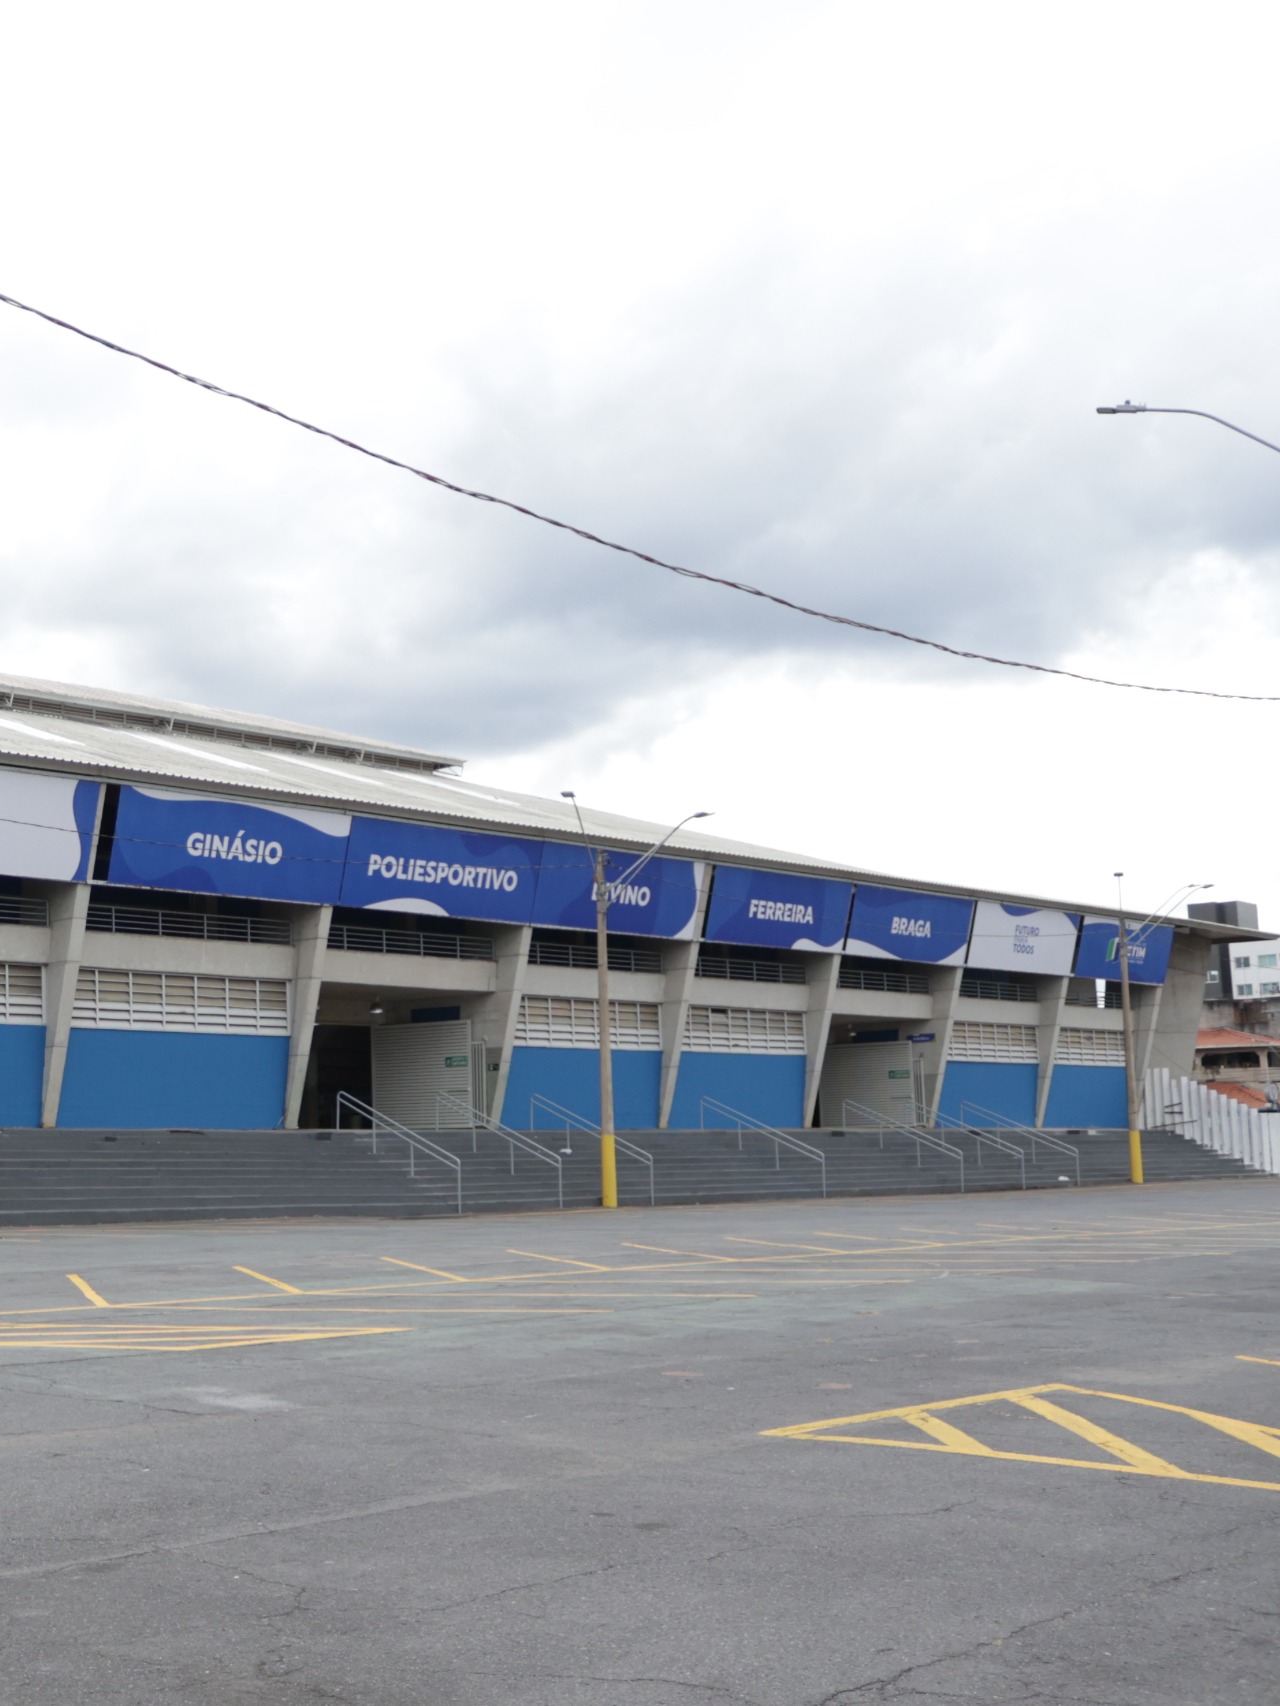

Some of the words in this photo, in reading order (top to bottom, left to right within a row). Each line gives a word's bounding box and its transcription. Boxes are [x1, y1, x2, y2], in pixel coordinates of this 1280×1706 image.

[186, 829, 283, 865] GINÁSIO
[367, 853, 519, 892] POLIESPORTIVO
[748, 899, 814, 925] FERREIRA
[890, 916, 932, 938] BRAGA
[1015, 924, 1040, 937] FUTURO
[1013, 943, 1035, 955] TODOS
